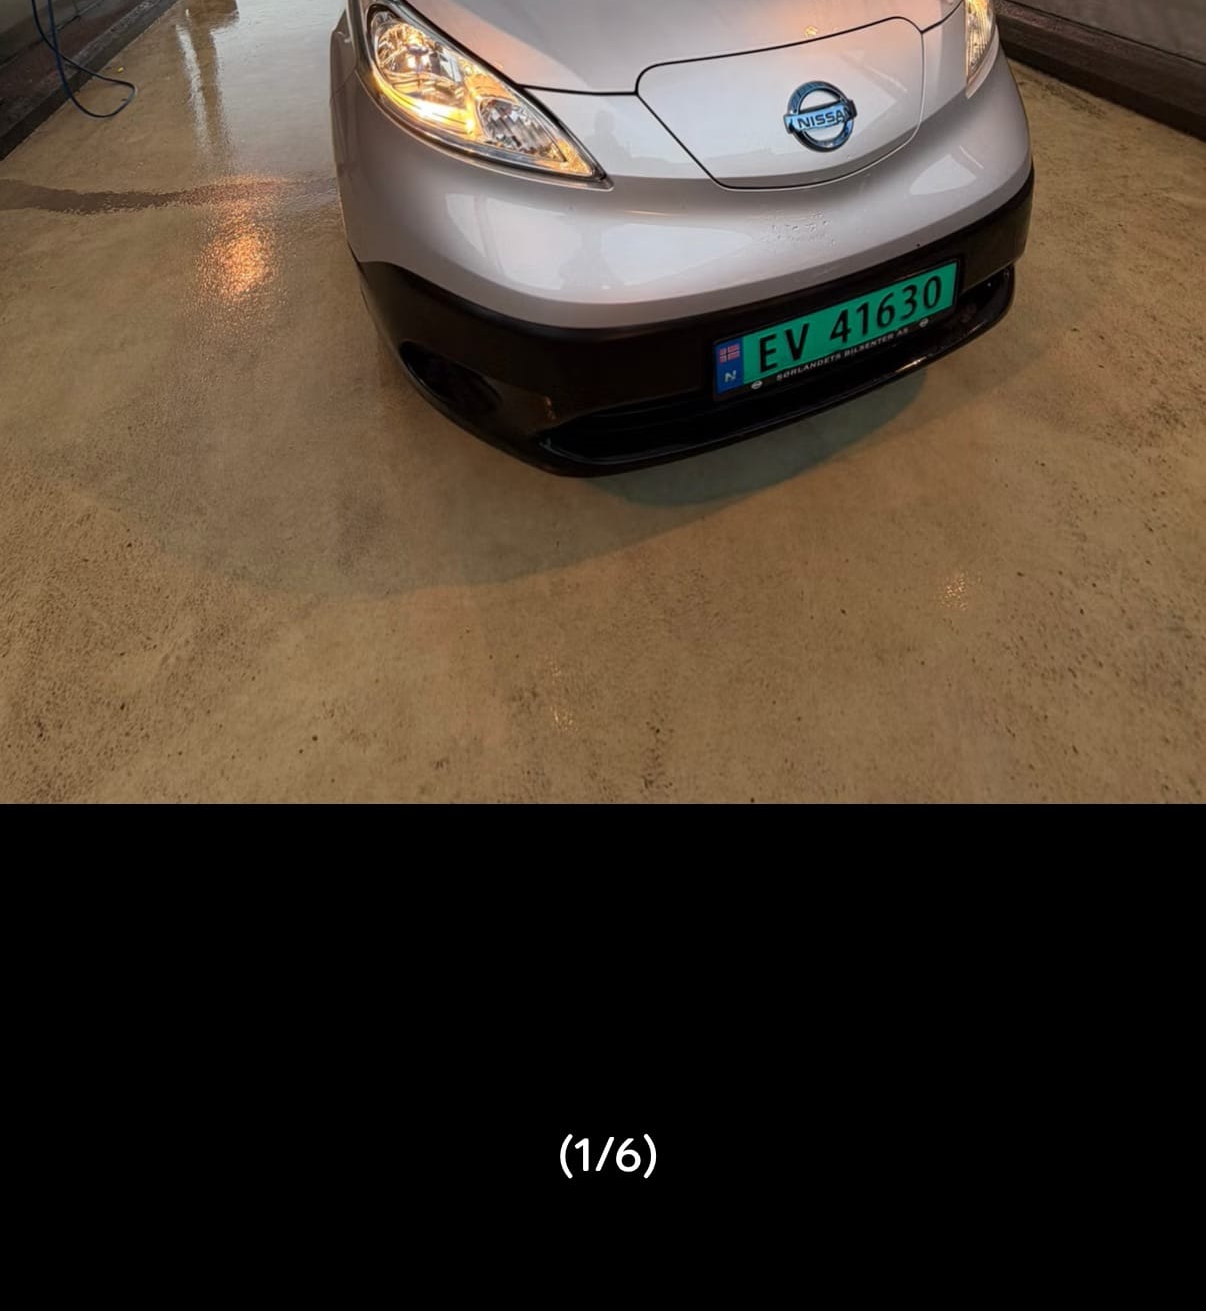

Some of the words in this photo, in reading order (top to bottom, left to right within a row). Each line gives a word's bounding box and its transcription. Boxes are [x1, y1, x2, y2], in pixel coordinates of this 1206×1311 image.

[759, 322, 811, 373] EV
[829, 275, 943, 344] 41630
[723, 369, 738, 383] N
[776, 351, 842, 382] SØRLANDETS
[844, 331, 895, 357] BILSENTER
